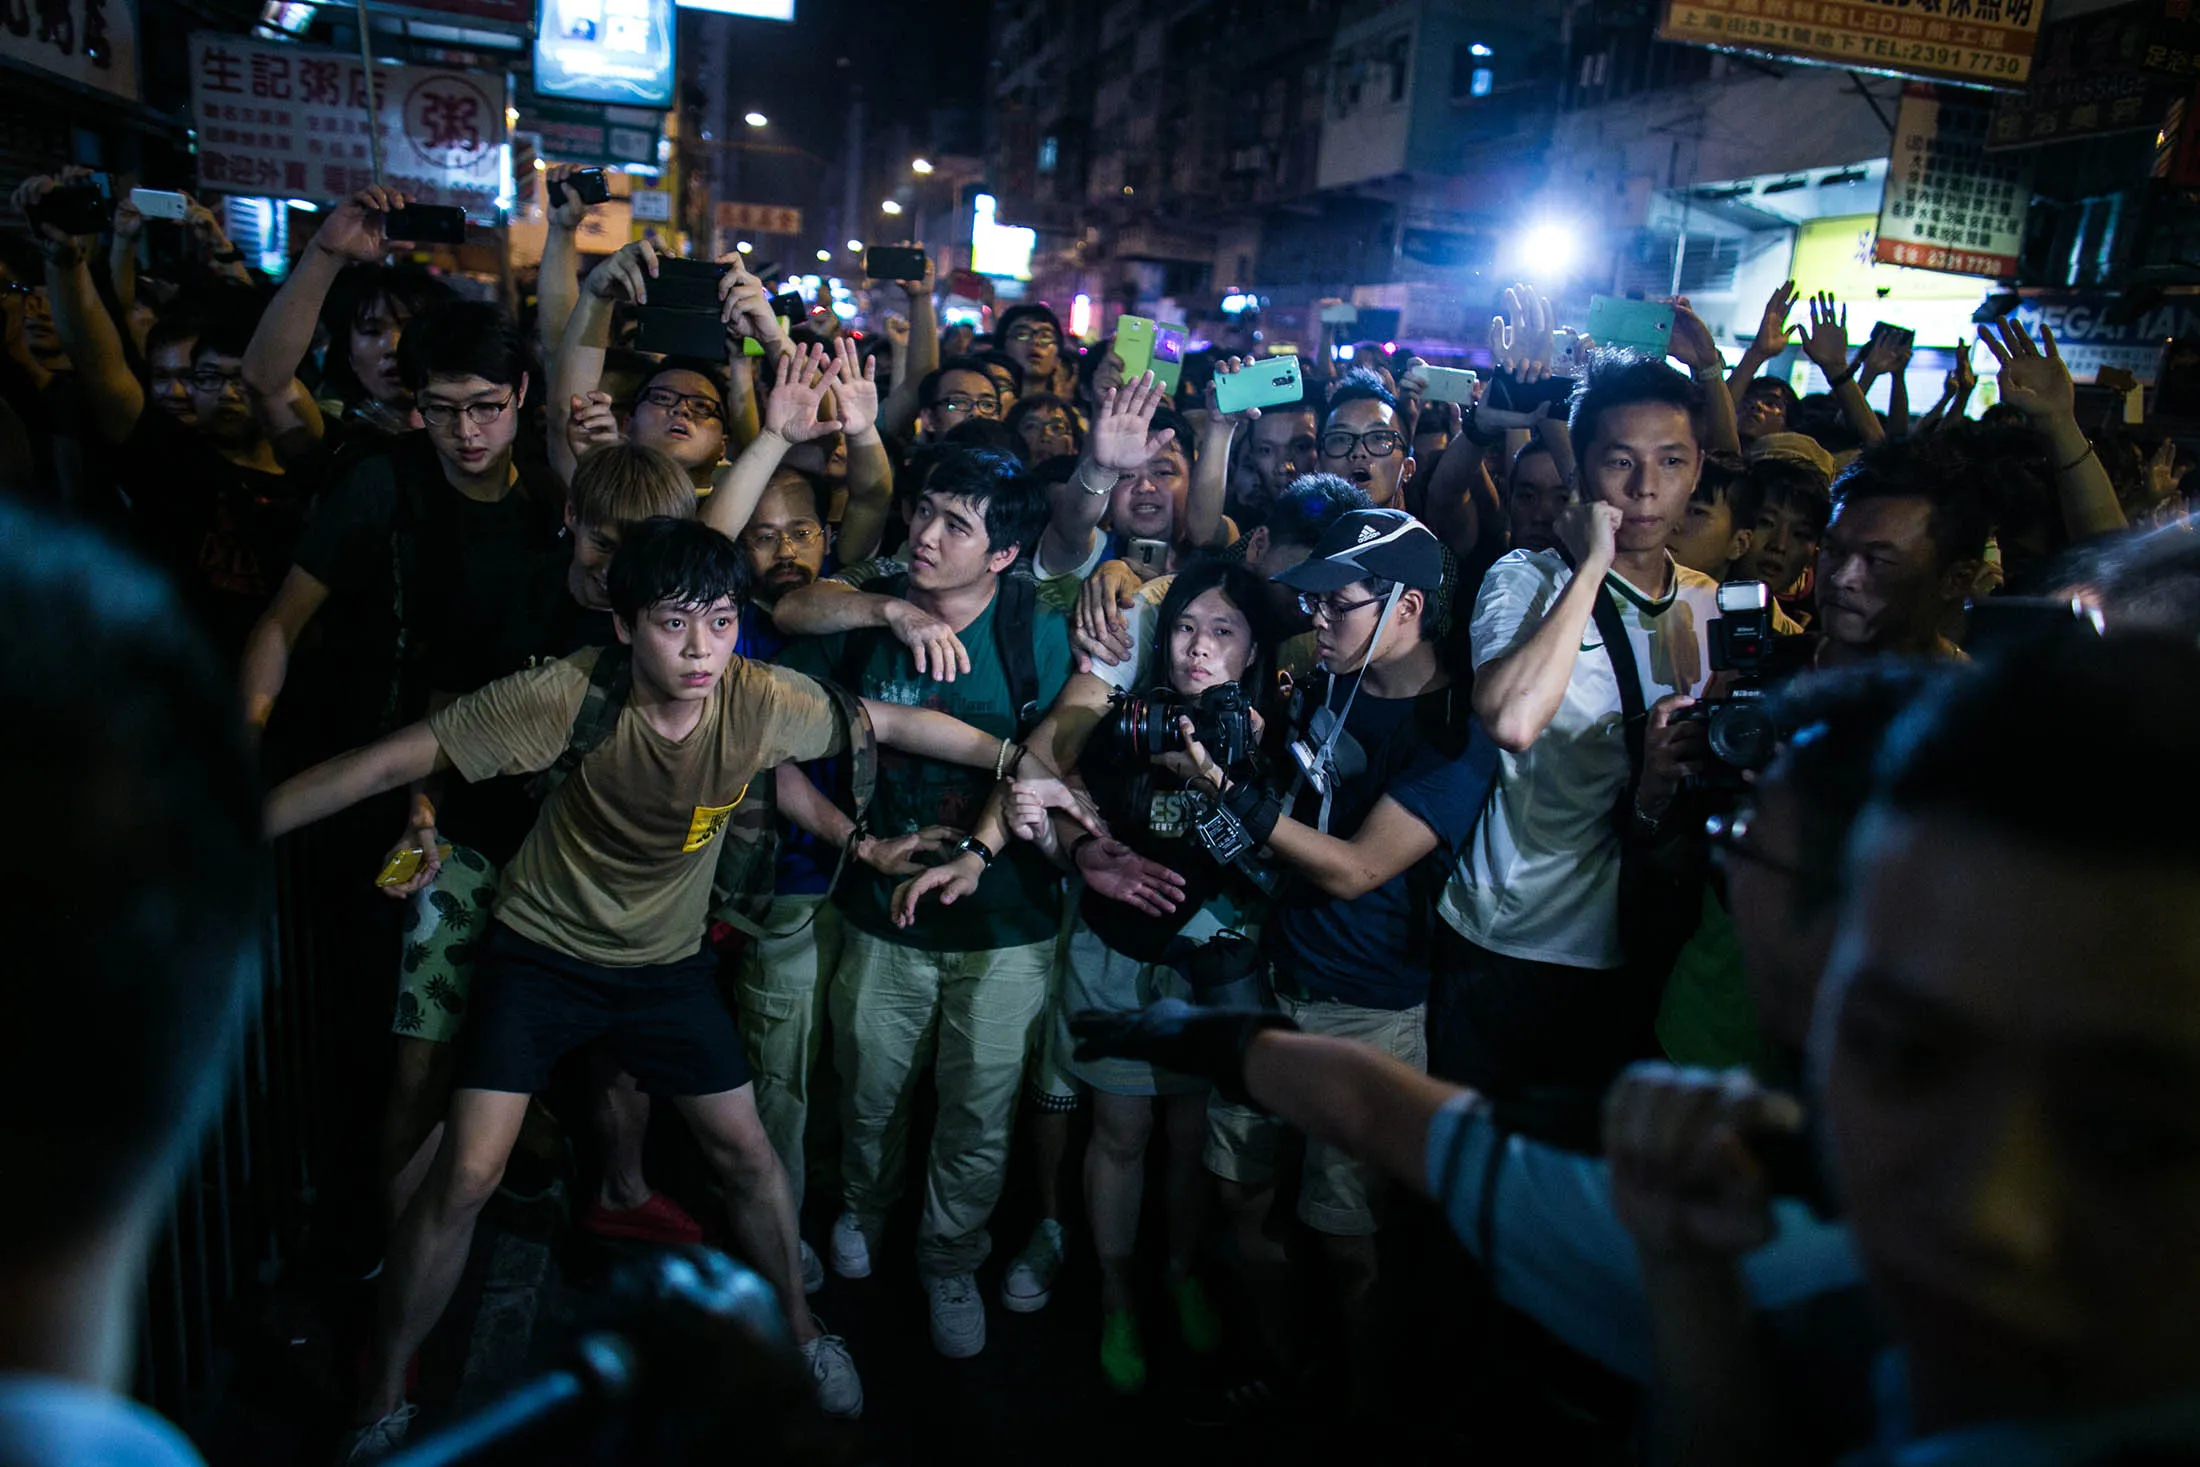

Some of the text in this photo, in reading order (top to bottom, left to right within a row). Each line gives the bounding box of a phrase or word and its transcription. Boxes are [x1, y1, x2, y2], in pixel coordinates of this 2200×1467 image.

[203, 47, 387, 110] 生記粥店
[1861, 37, 1962, 67] TEL:2391
[1969, 52, 2021, 74] 7730
[420, 92, 479, 151] 粥
